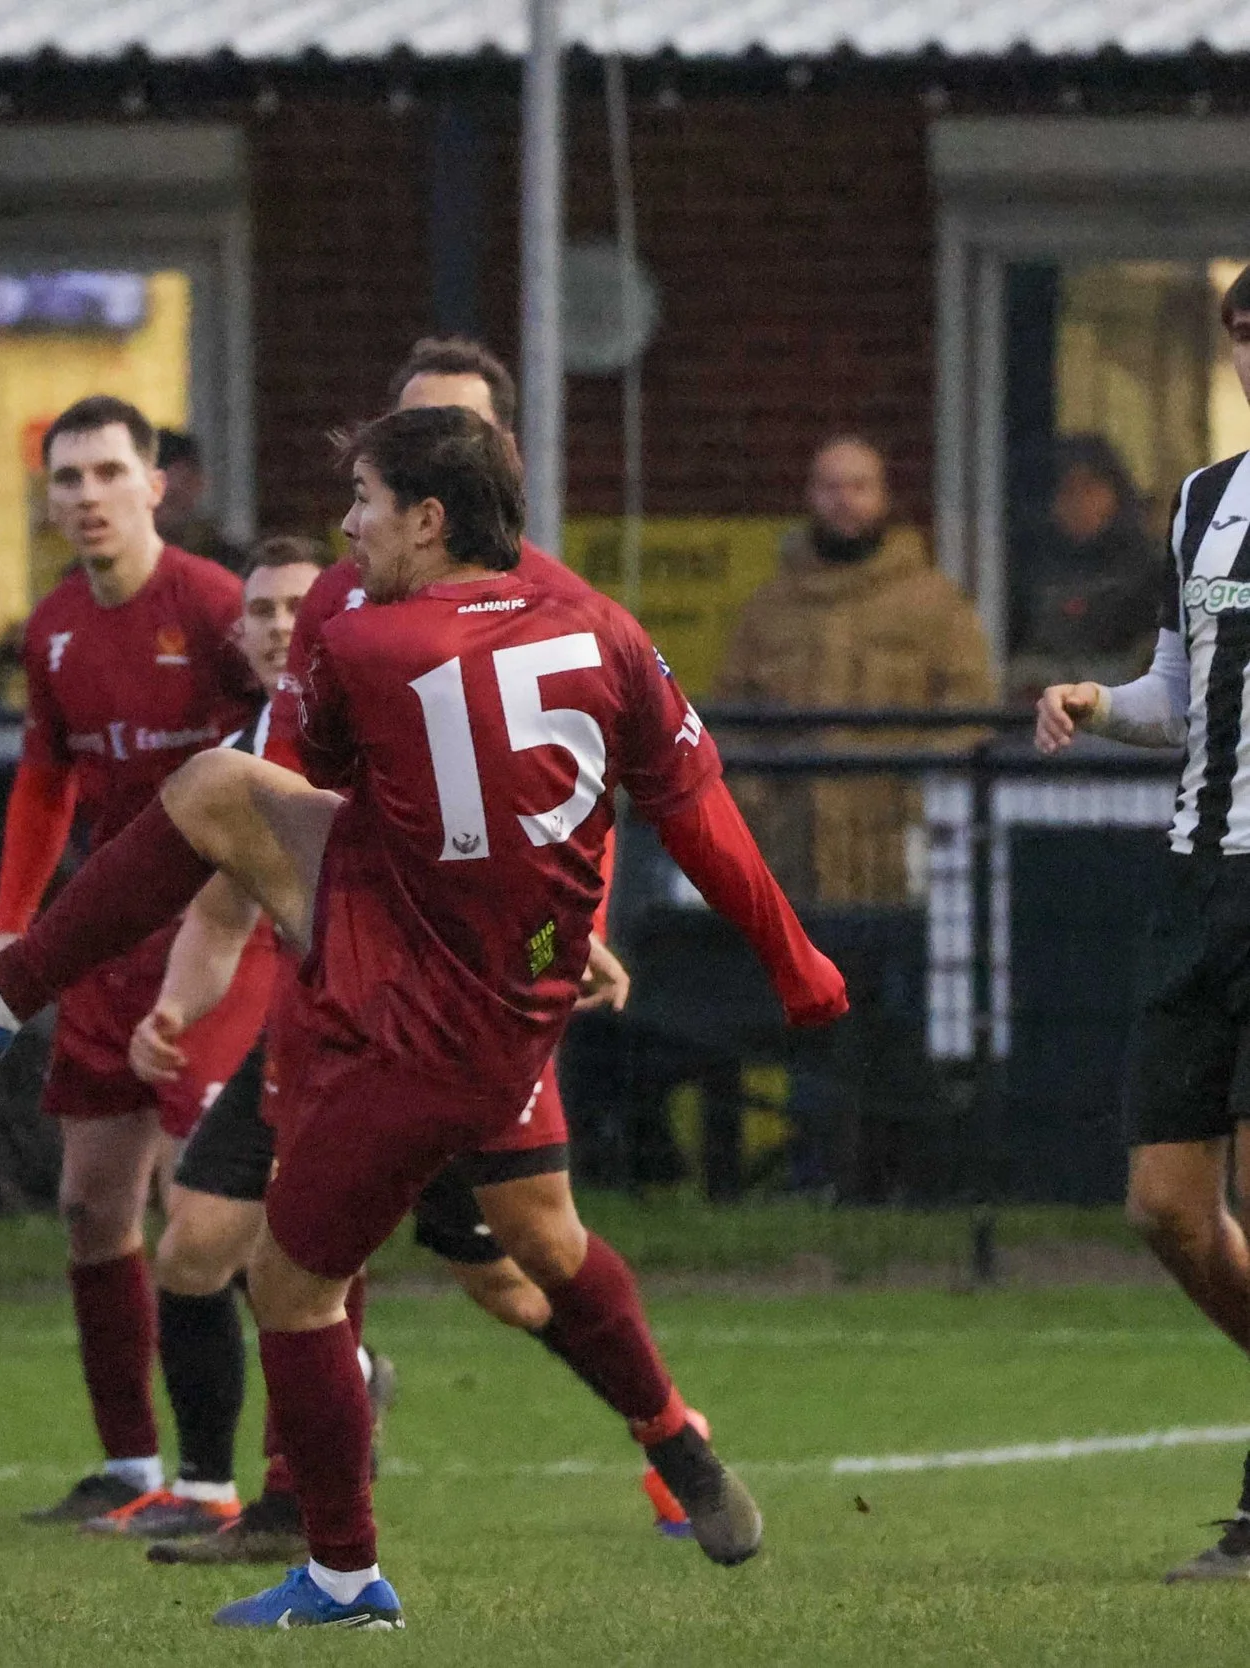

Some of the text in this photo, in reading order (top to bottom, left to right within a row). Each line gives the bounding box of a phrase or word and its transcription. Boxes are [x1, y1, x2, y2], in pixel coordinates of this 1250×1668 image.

[457, 598, 527, 614] BALHAM FC
[406, 632, 606, 861] 15
